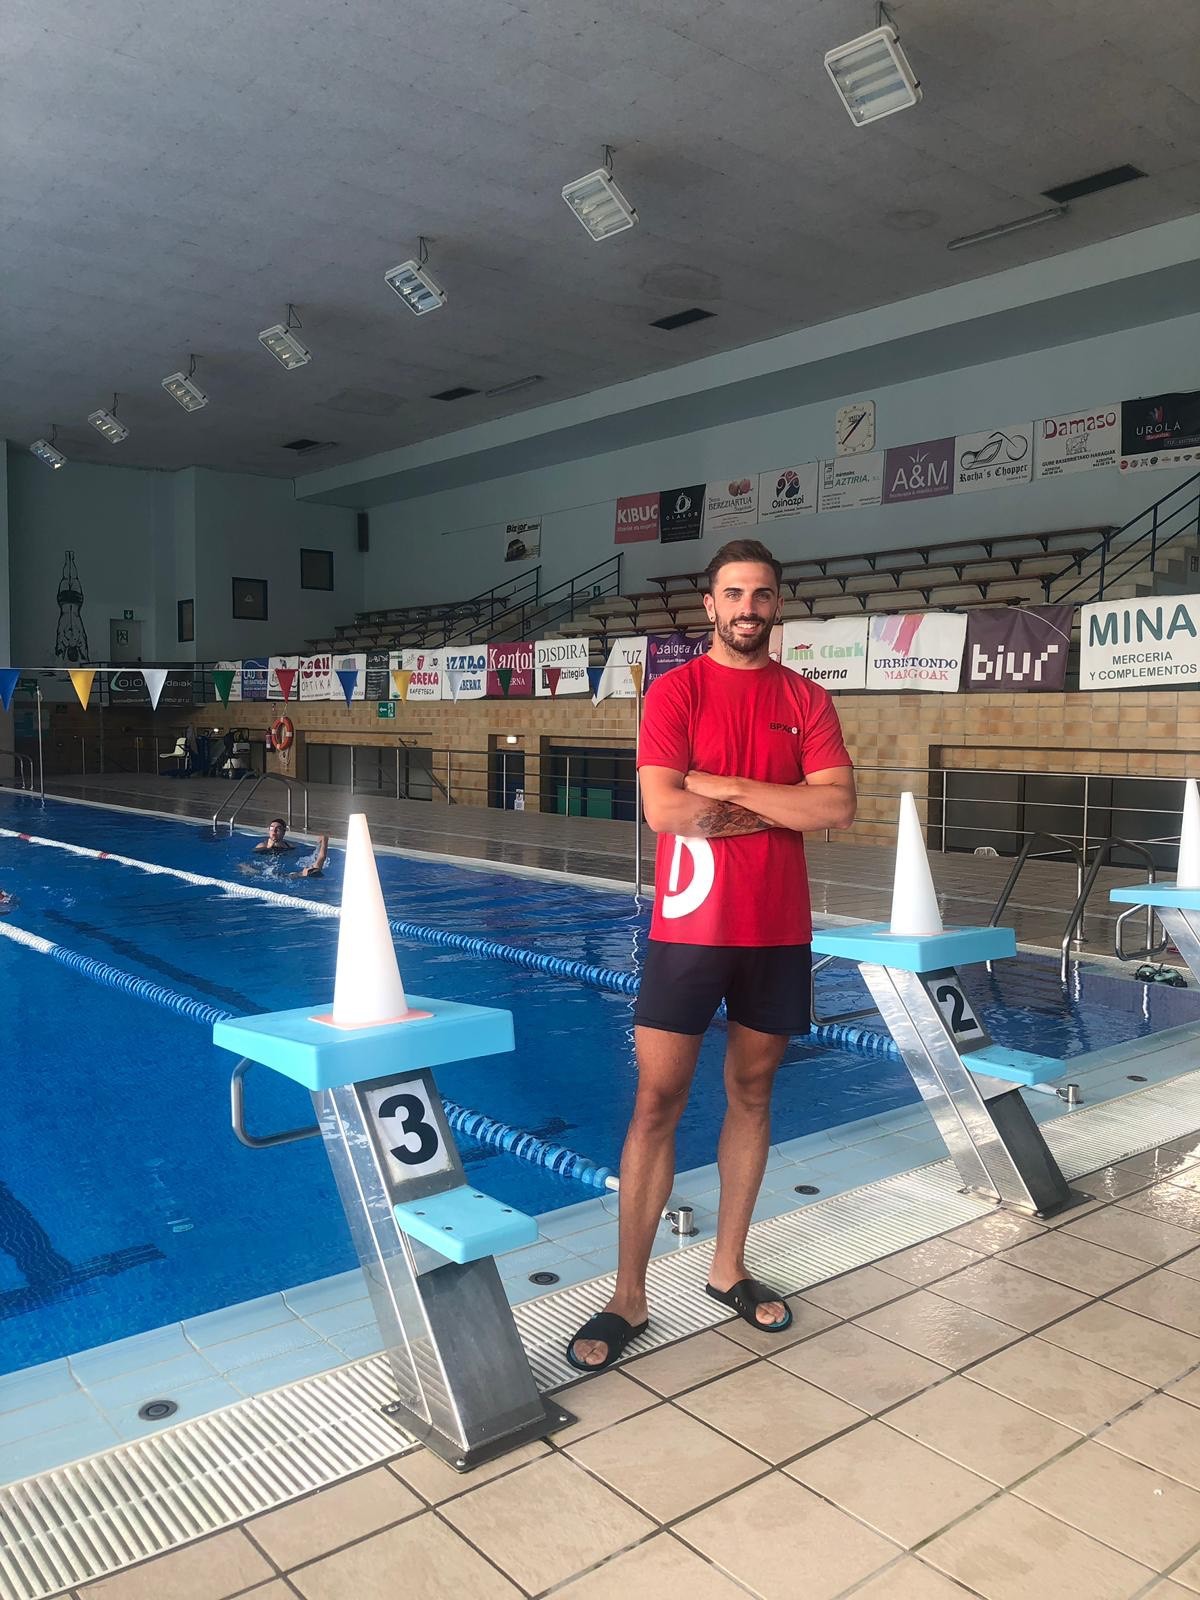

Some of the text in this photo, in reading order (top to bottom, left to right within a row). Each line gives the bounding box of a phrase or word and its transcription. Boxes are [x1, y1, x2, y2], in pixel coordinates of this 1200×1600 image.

[1042, 412, 1117, 440] Damaso
[1136, 421, 1182, 436] UROLA
[891, 460, 949, 493] A&M
[995, 464, 1029, 478] Chopper
[617, 504, 659, 525] KIBUC
[1089, 604, 1197, 648] MINA
[489, 643, 534, 674] Kantoi
[538, 643, 588, 664] DISDIRA
[820, 642, 865, 659] Clark
[1112, 651, 1173, 666] MERCERIA
[801, 667, 848, 681] Taberna
[1090, 663, 1198, 681] Y COMPLEMENTOS
[936, 985, 979, 1034] 2
[378, 1093, 439, 1166] 3
